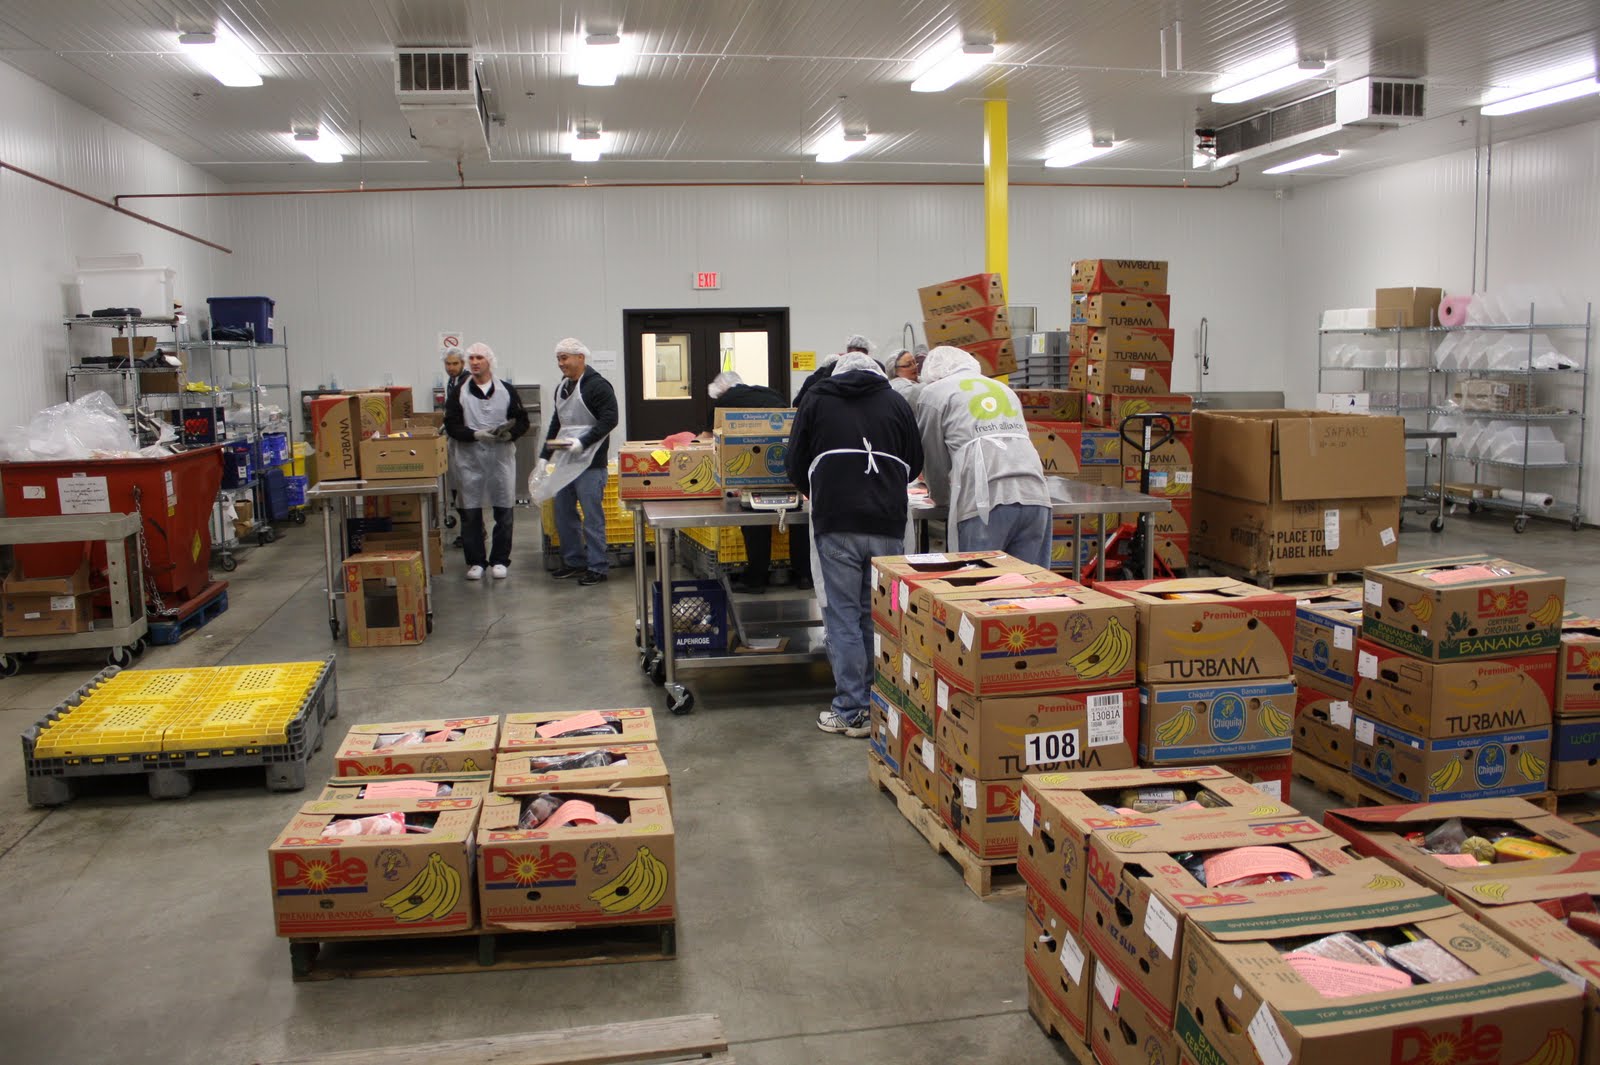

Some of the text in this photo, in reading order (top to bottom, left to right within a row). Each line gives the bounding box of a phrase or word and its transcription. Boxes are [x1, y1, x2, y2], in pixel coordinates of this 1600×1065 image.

[698, 273, 717, 287] EXIT
[1109, 317, 1153, 326] TURBANA
[1113, 352, 1158, 361] TURBANA
[1112, 385, 1155, 394] TURBANA
[974, 421, 998, 433] fresh
[338, 417, 353, 470] TURBANA
[1131, 455, 1177, 464] TUBANA
[1277, 530, 1307, 544] PLACE
[1277, 546, 1306, 559] LABEL
[1478, 585, 1529, 614] Dole
[1203, 609, 1291, 620] Premium Bananas
[1487, 616, 1520, 627] CERTIFIED
[981, 615, 1059, 653] Dole
[1379, 623, 1413, 641] BANANAS
[1484, 624, 1522, 635] ORGANIC
[677, 637, 710, 646] ALPENROSE
[1459, 633, 1543, 654] BANANAS
[1164, 656, 1260, 679] TURBANA
[1478, 662, 1553, 677] Premium Bananas
[981, 670, 1062, 683] PREMIUM BANANAS
[1188, 687, 1267, 699] Chiquita Bananas
[1038, 703, 1086, 714] Premium
[1091, 710, 1121, 721] 13081A
[1446, 708, 1527, 734] TURBANA
[1213, 718, 1243, 731] Chiquita
[1030, 732, 1076, 761] 108
[1457, 734, 1525, 748] Chiquita Bananas
[1155, 766, 1224, 781] Dole
[1478, 764, 1504, 777] Chiquita
[417, 799, 473, 810] Dole
[1082, 815, 1156, 830] Dole
[489, 830, 549, 841] Dole
[1253, 821, 1322, 839] Dole
[283, 836, 344, 846] Dole
[274, 850, 369, 892] Dole
[484, 844, 577, 888] Dole
[1088, 846, 1117, 896] Dole
[1171, 891, 1249, 907] Dole
[487, 904, 582, 916] PREMIUM BANANAS
[1361, 905, 1400, 916] QUALITY
[1403, 902, 1422, 911] TOP
[280, 910, 375, 921] PREMIUM BANANAS
[1107, 922, 1137, 955] EZ SLIP
[1317, 1010, 1338, 1019] TOP
[1343, 1004, 1387, 1016] QUALITY
[1391, 1015, 1503, 1065] Dole
